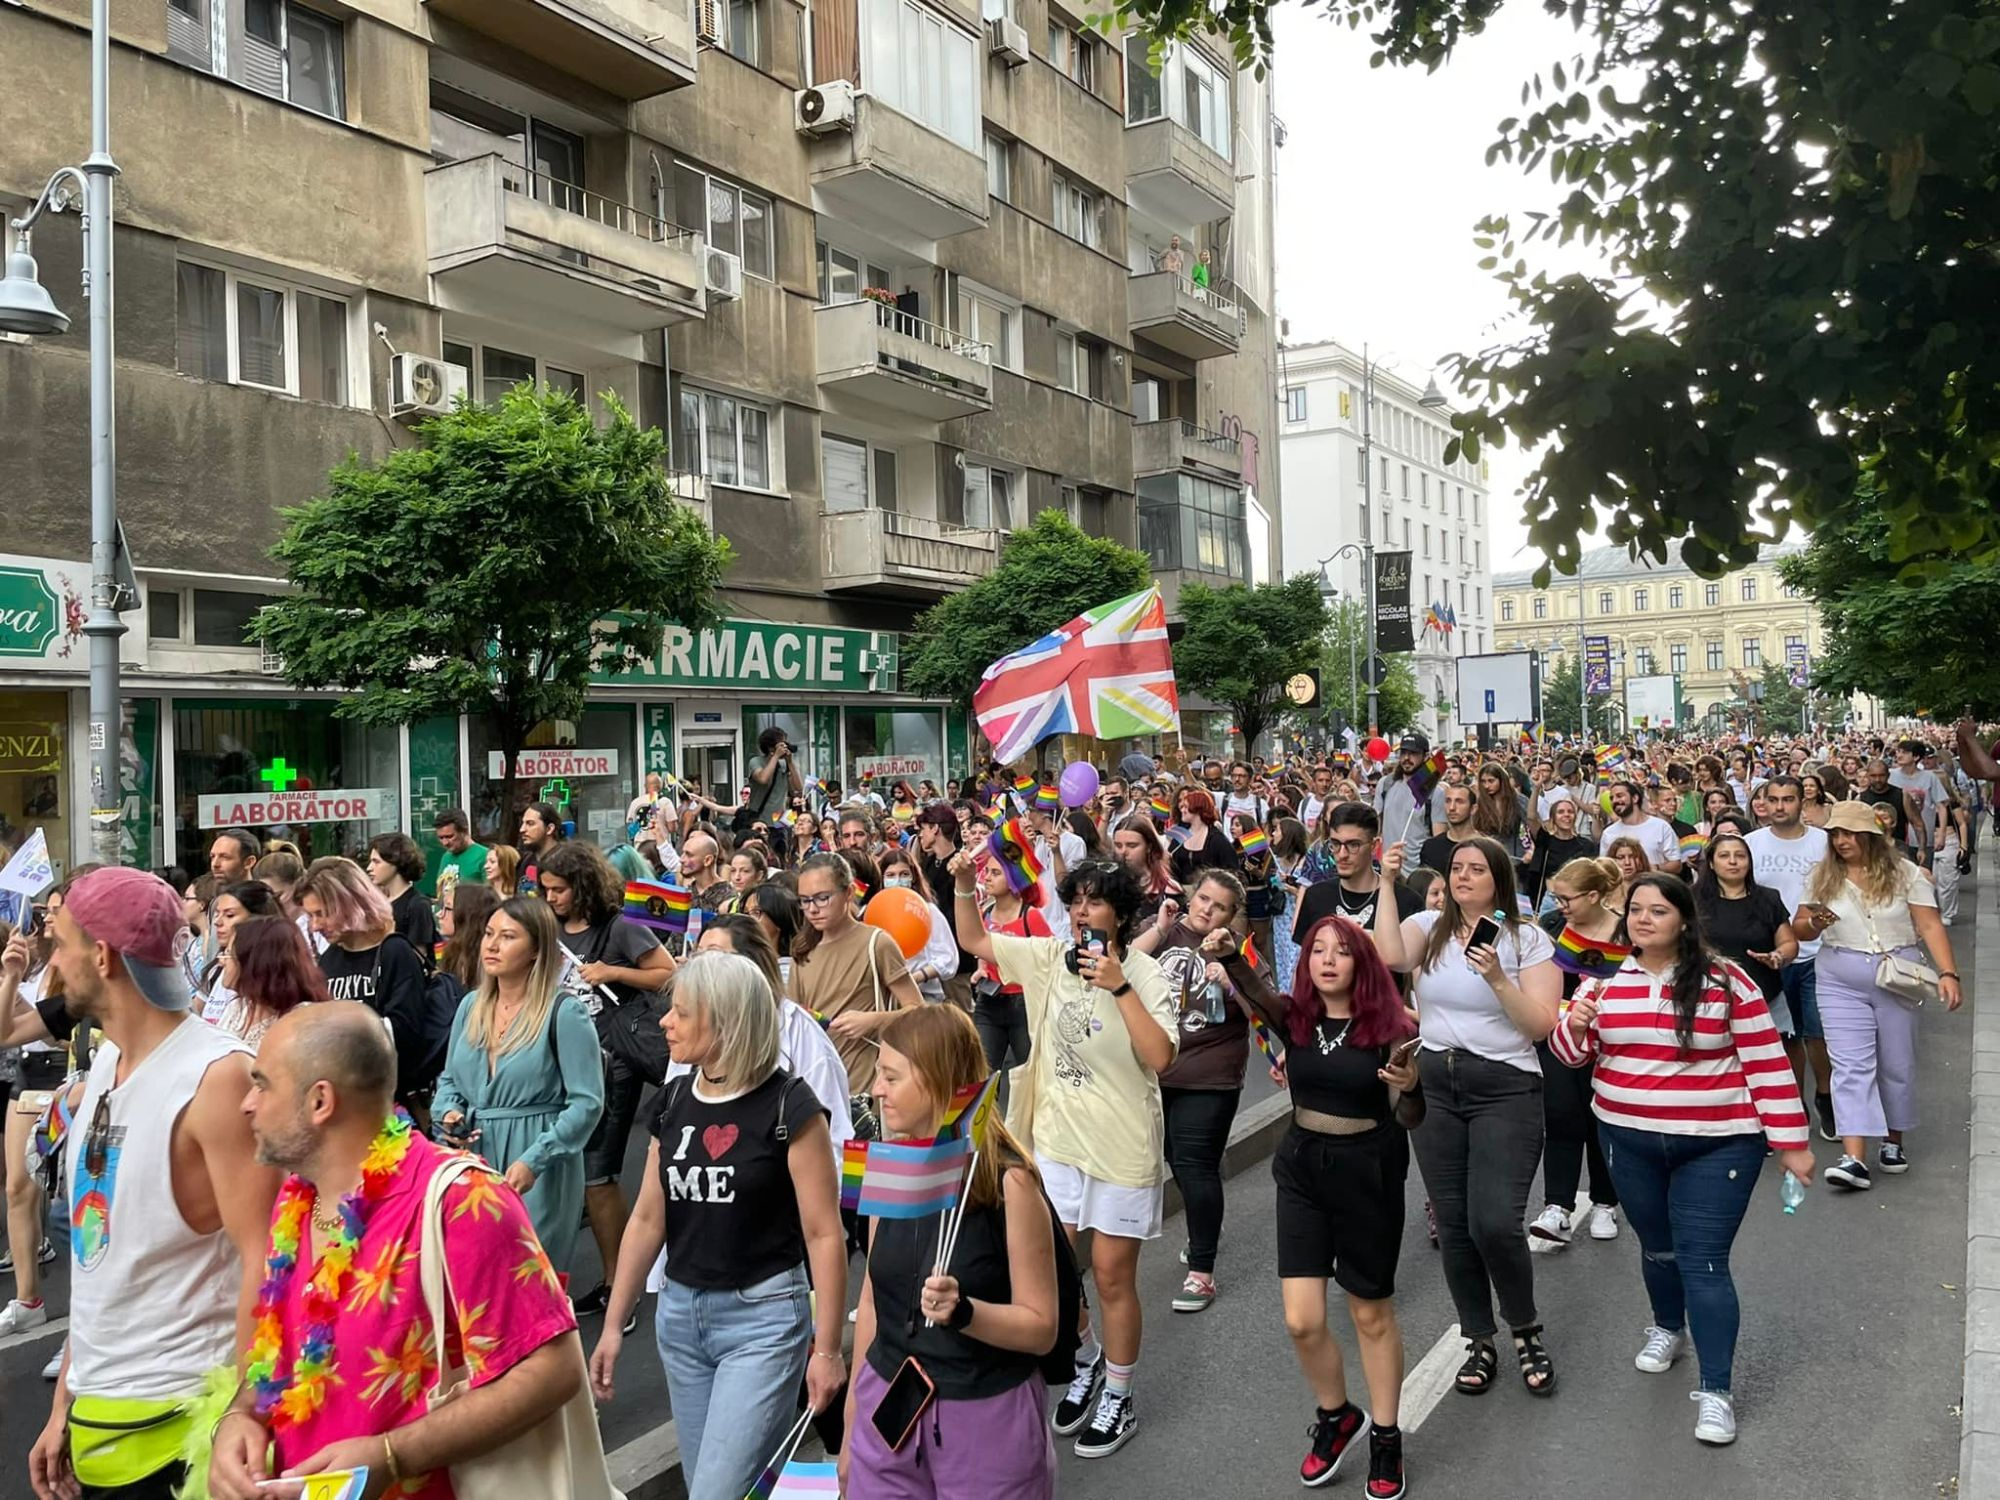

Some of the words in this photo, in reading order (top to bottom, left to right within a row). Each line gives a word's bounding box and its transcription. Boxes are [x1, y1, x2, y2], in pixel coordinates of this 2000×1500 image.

[1378, 606, 1408, 614] NICOLAE
[590, 619, 845, 682] FARMACIE
[269, 792, 318, 801] FARMACIE
[213, 799, 368, 825] LABORATOR
[672, 1125, 696, 1160] I
[666, 1165, 736, 1203] ME
